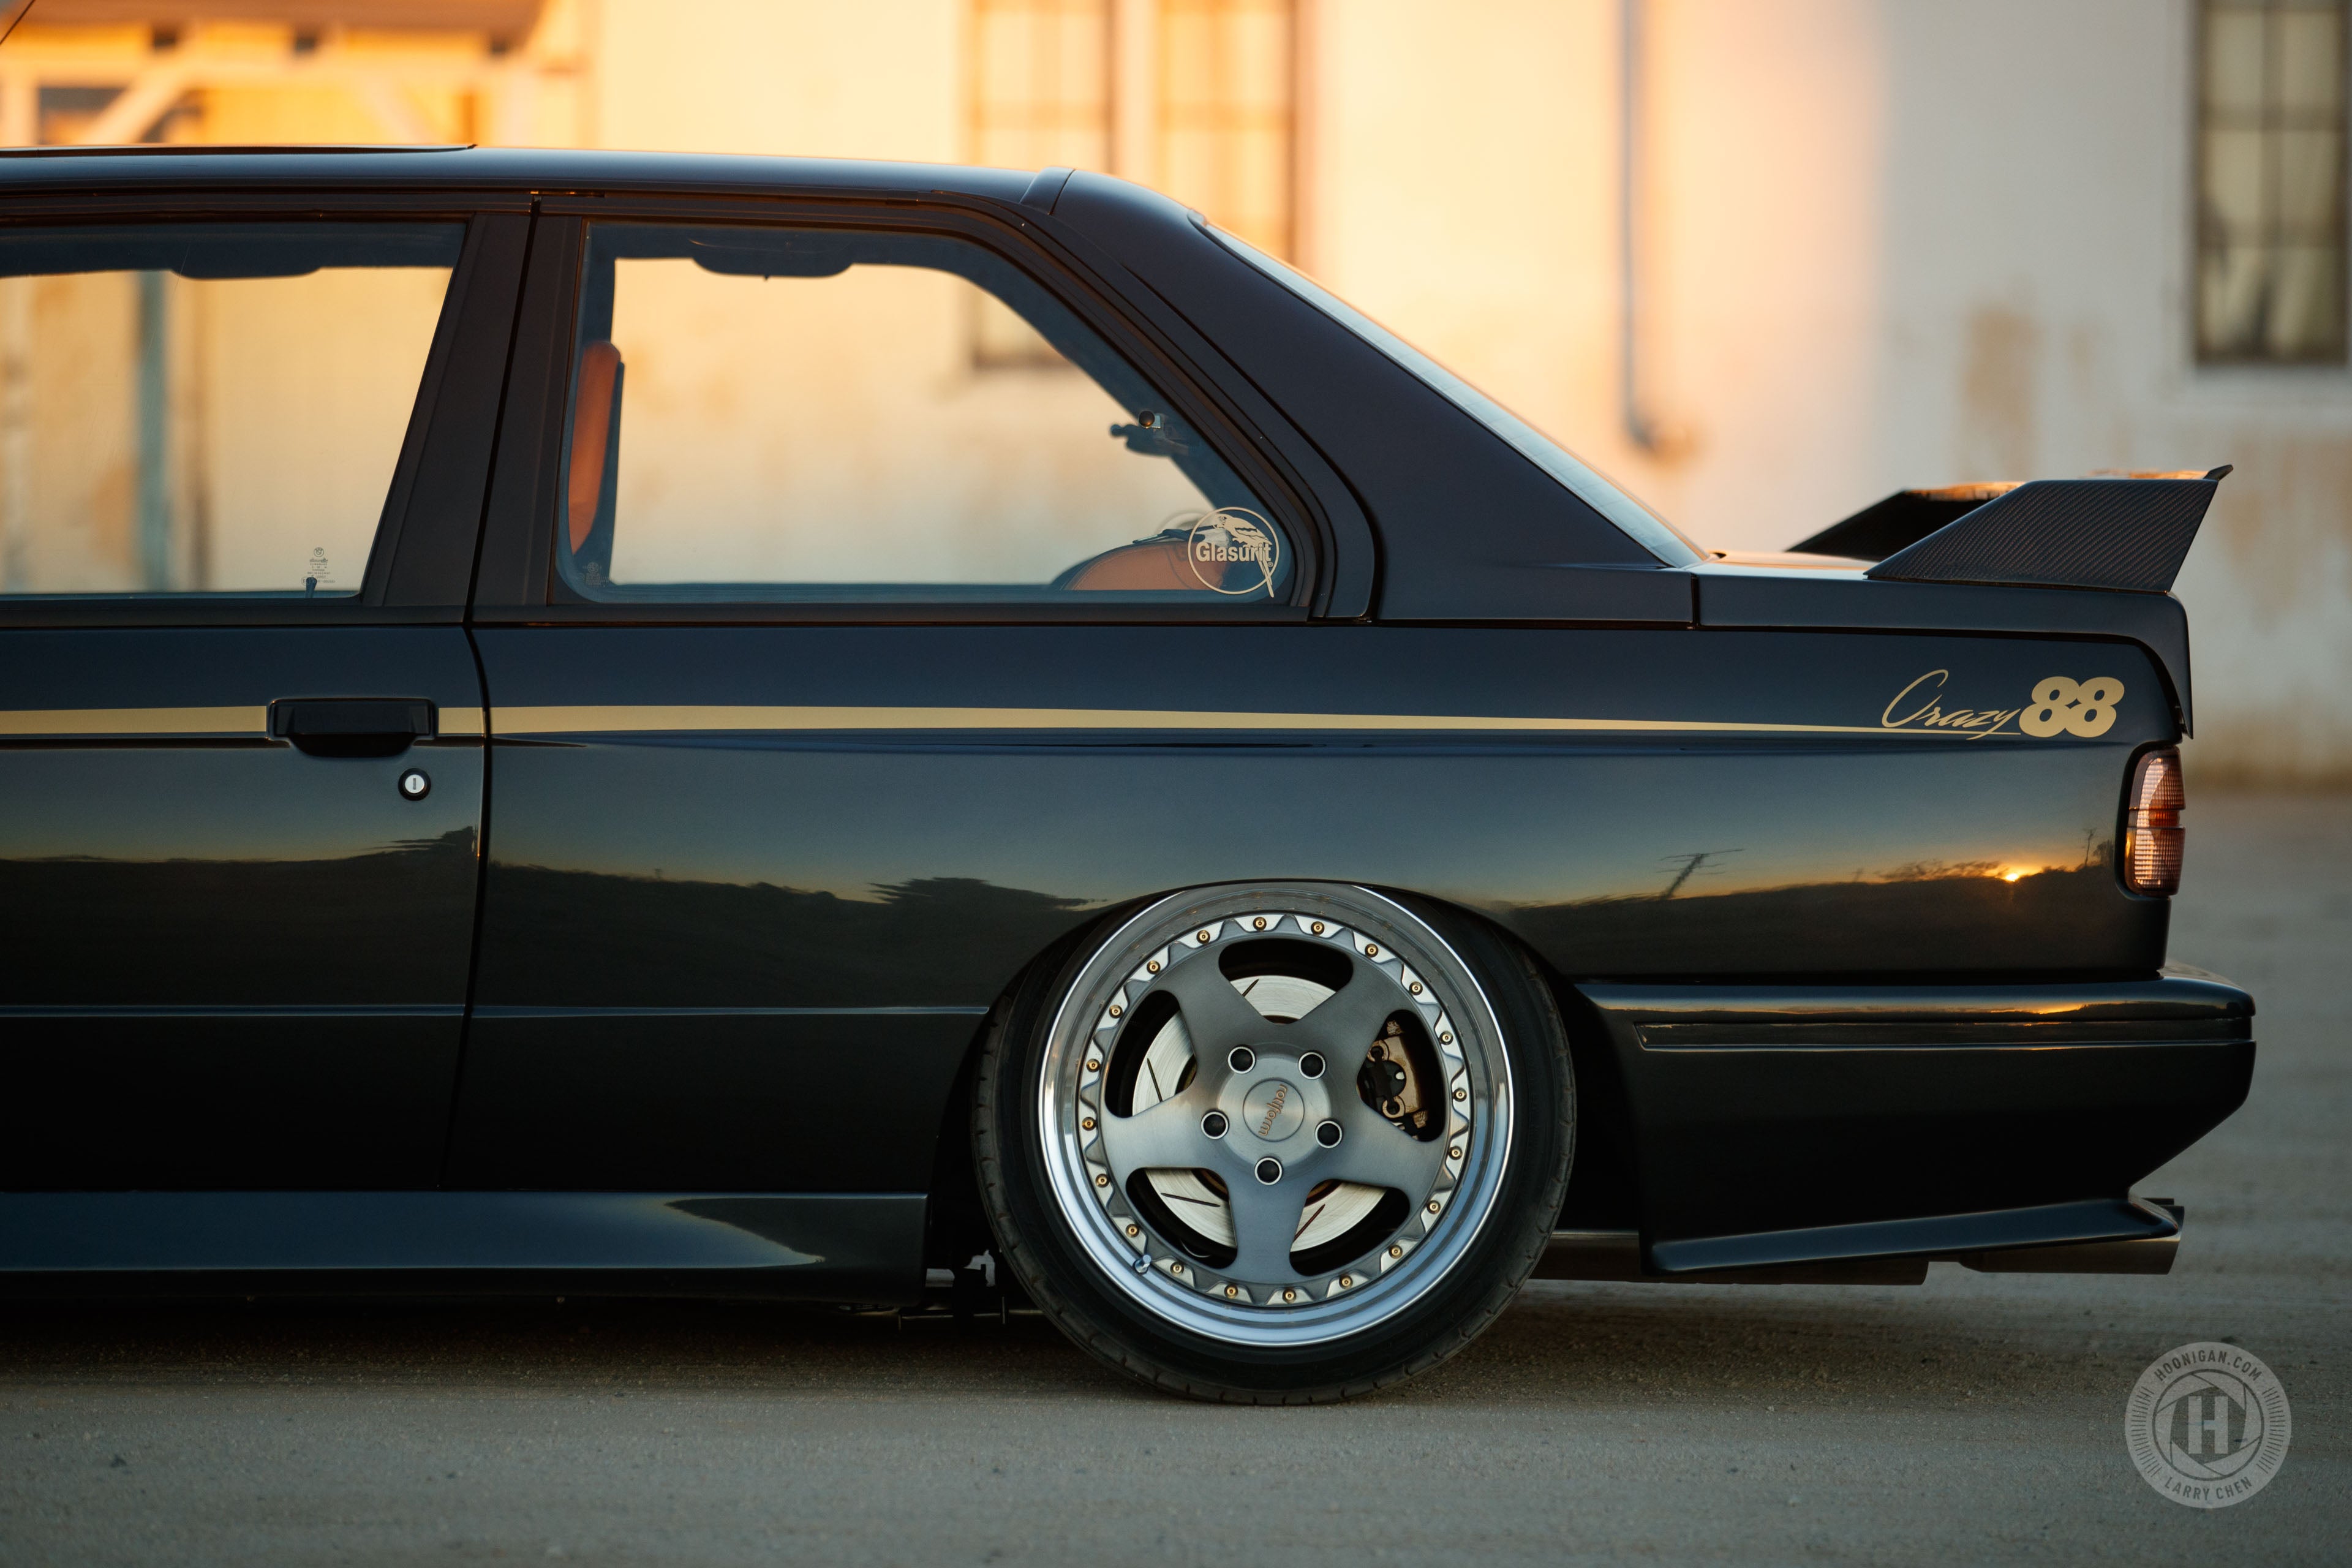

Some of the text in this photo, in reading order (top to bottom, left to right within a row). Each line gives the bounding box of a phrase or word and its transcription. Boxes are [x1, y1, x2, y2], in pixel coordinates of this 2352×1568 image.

[1196, 541, 1272, 562] Glasurit
[1882, 669, 2125, 741] Crazy 88
[1258, 1083, 1288, 1137] rotiform
